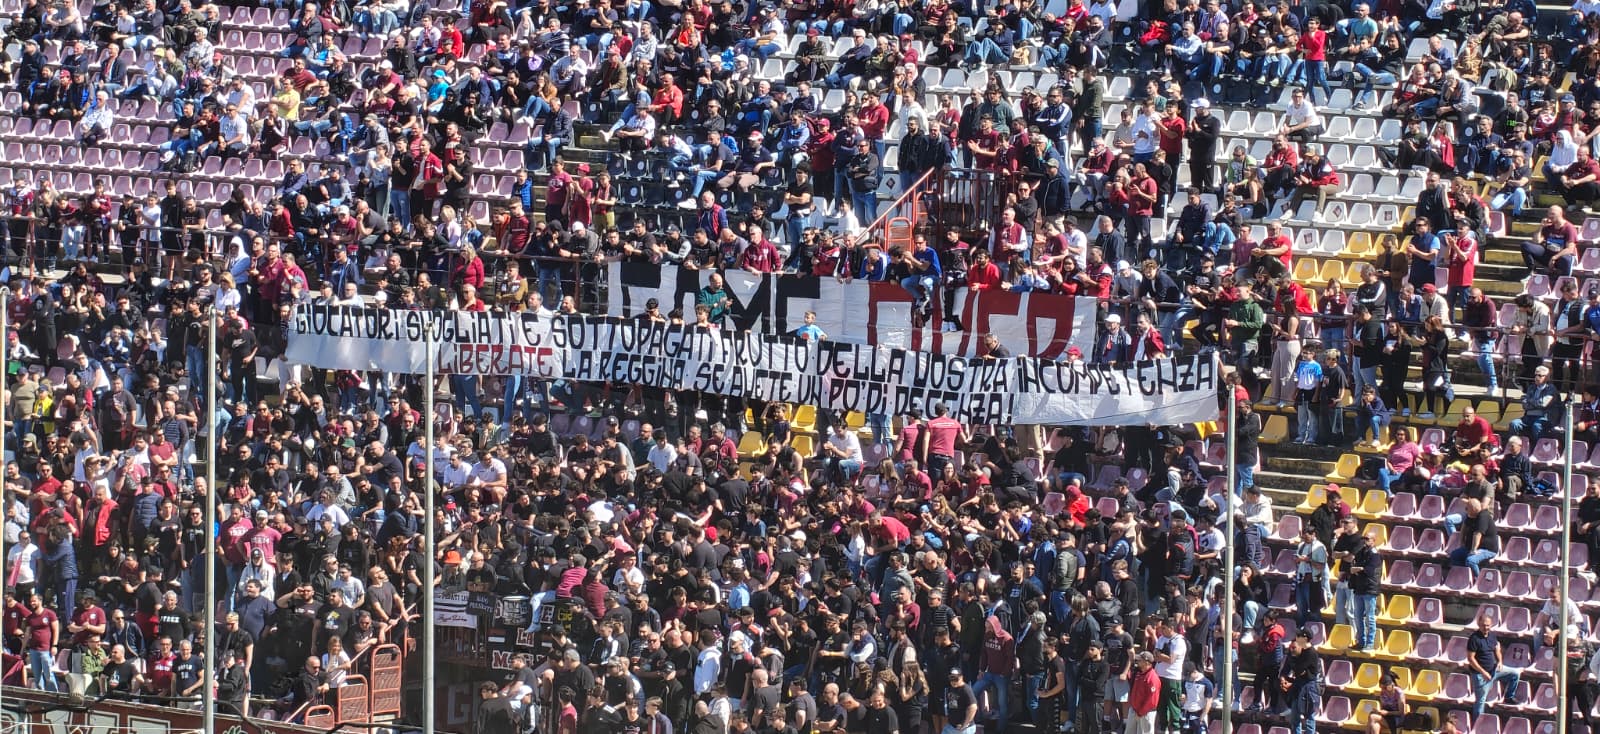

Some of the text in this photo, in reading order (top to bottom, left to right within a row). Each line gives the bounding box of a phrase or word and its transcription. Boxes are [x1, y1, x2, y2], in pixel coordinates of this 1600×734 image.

[522, 312, 541, 345] E
[551, 314, 714, 362] SOTTOPAGATI
[720, 329, 810, 375] FRUTTO
[817, 339, 905, 384] DELLA
[915, 351, 1009, 393] VOSTRA
[562, 349, 592, 379] LA
[693, 362, 725, 392] SE
[731, 365, 793, 401] AVETE
[798, 374, 823, 408] UN
